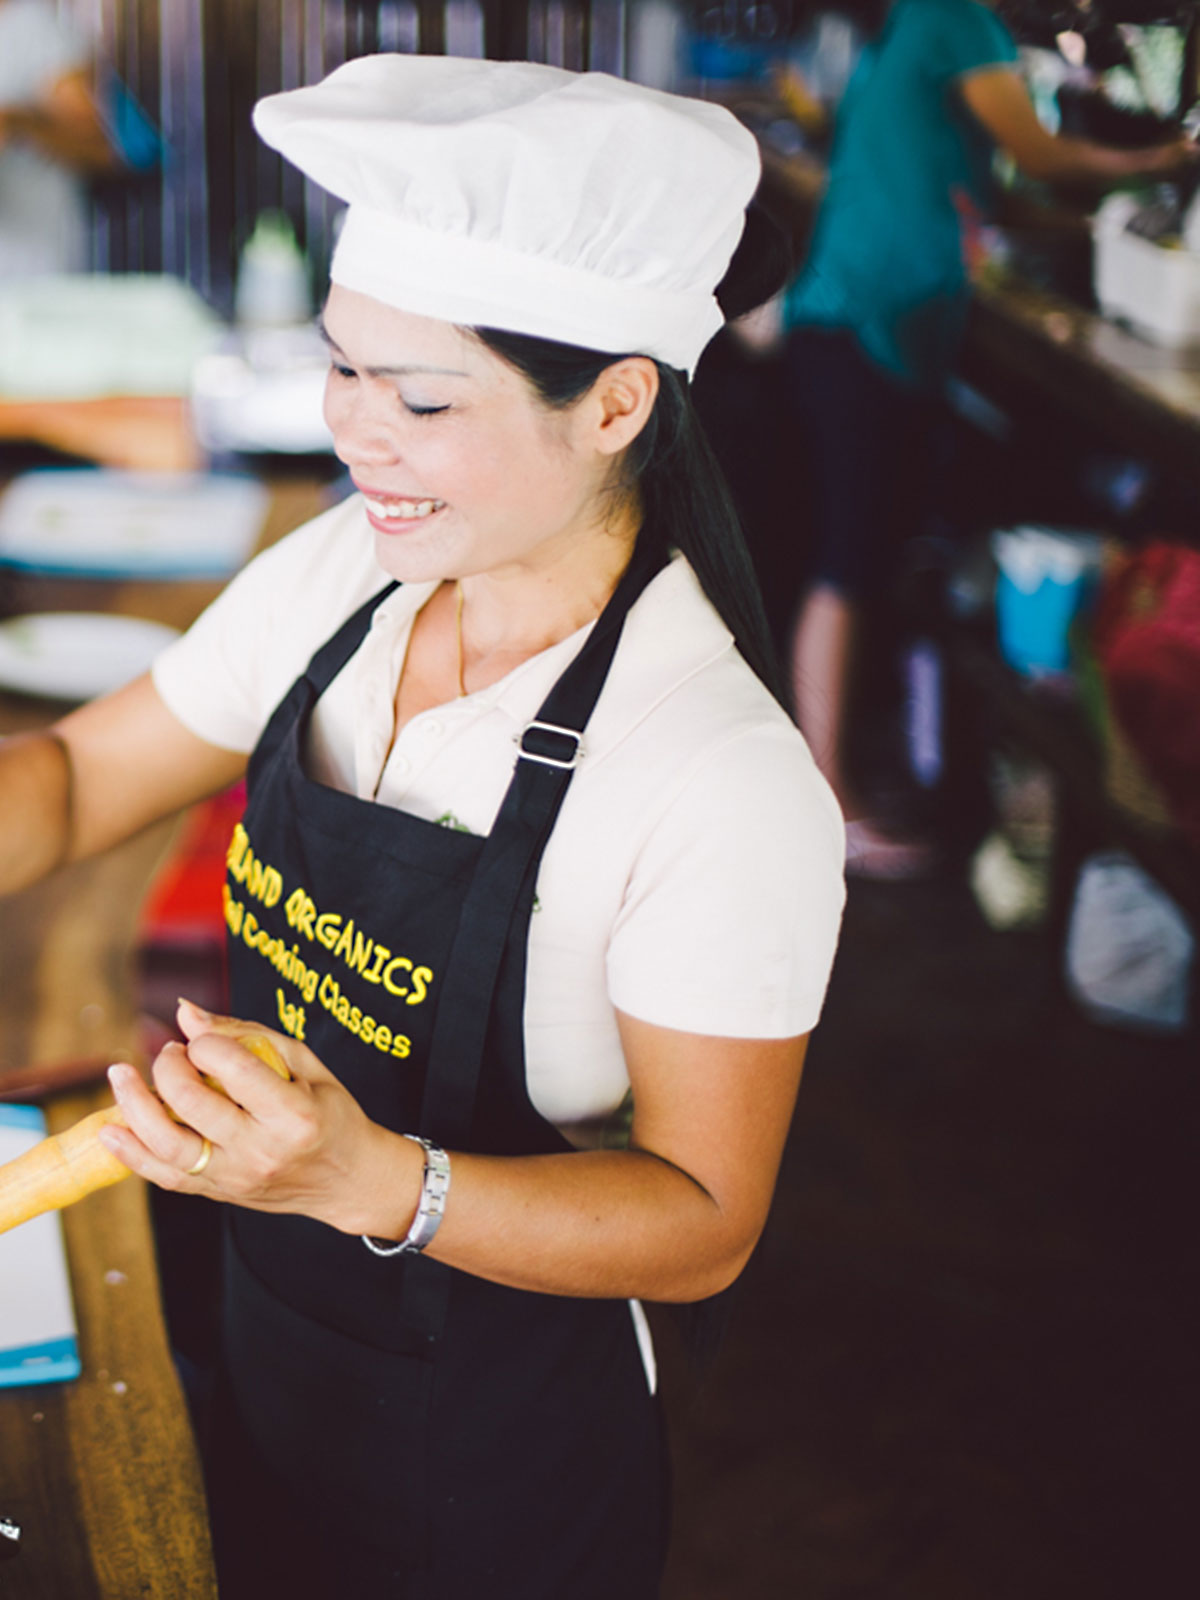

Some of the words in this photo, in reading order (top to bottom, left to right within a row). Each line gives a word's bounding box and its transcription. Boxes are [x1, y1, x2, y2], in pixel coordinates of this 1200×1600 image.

[242, 911, 320, 1004] Cooking
[318, 973, 412, 1059] Classes
[284, 887, 434, 1006] ORGANICS
